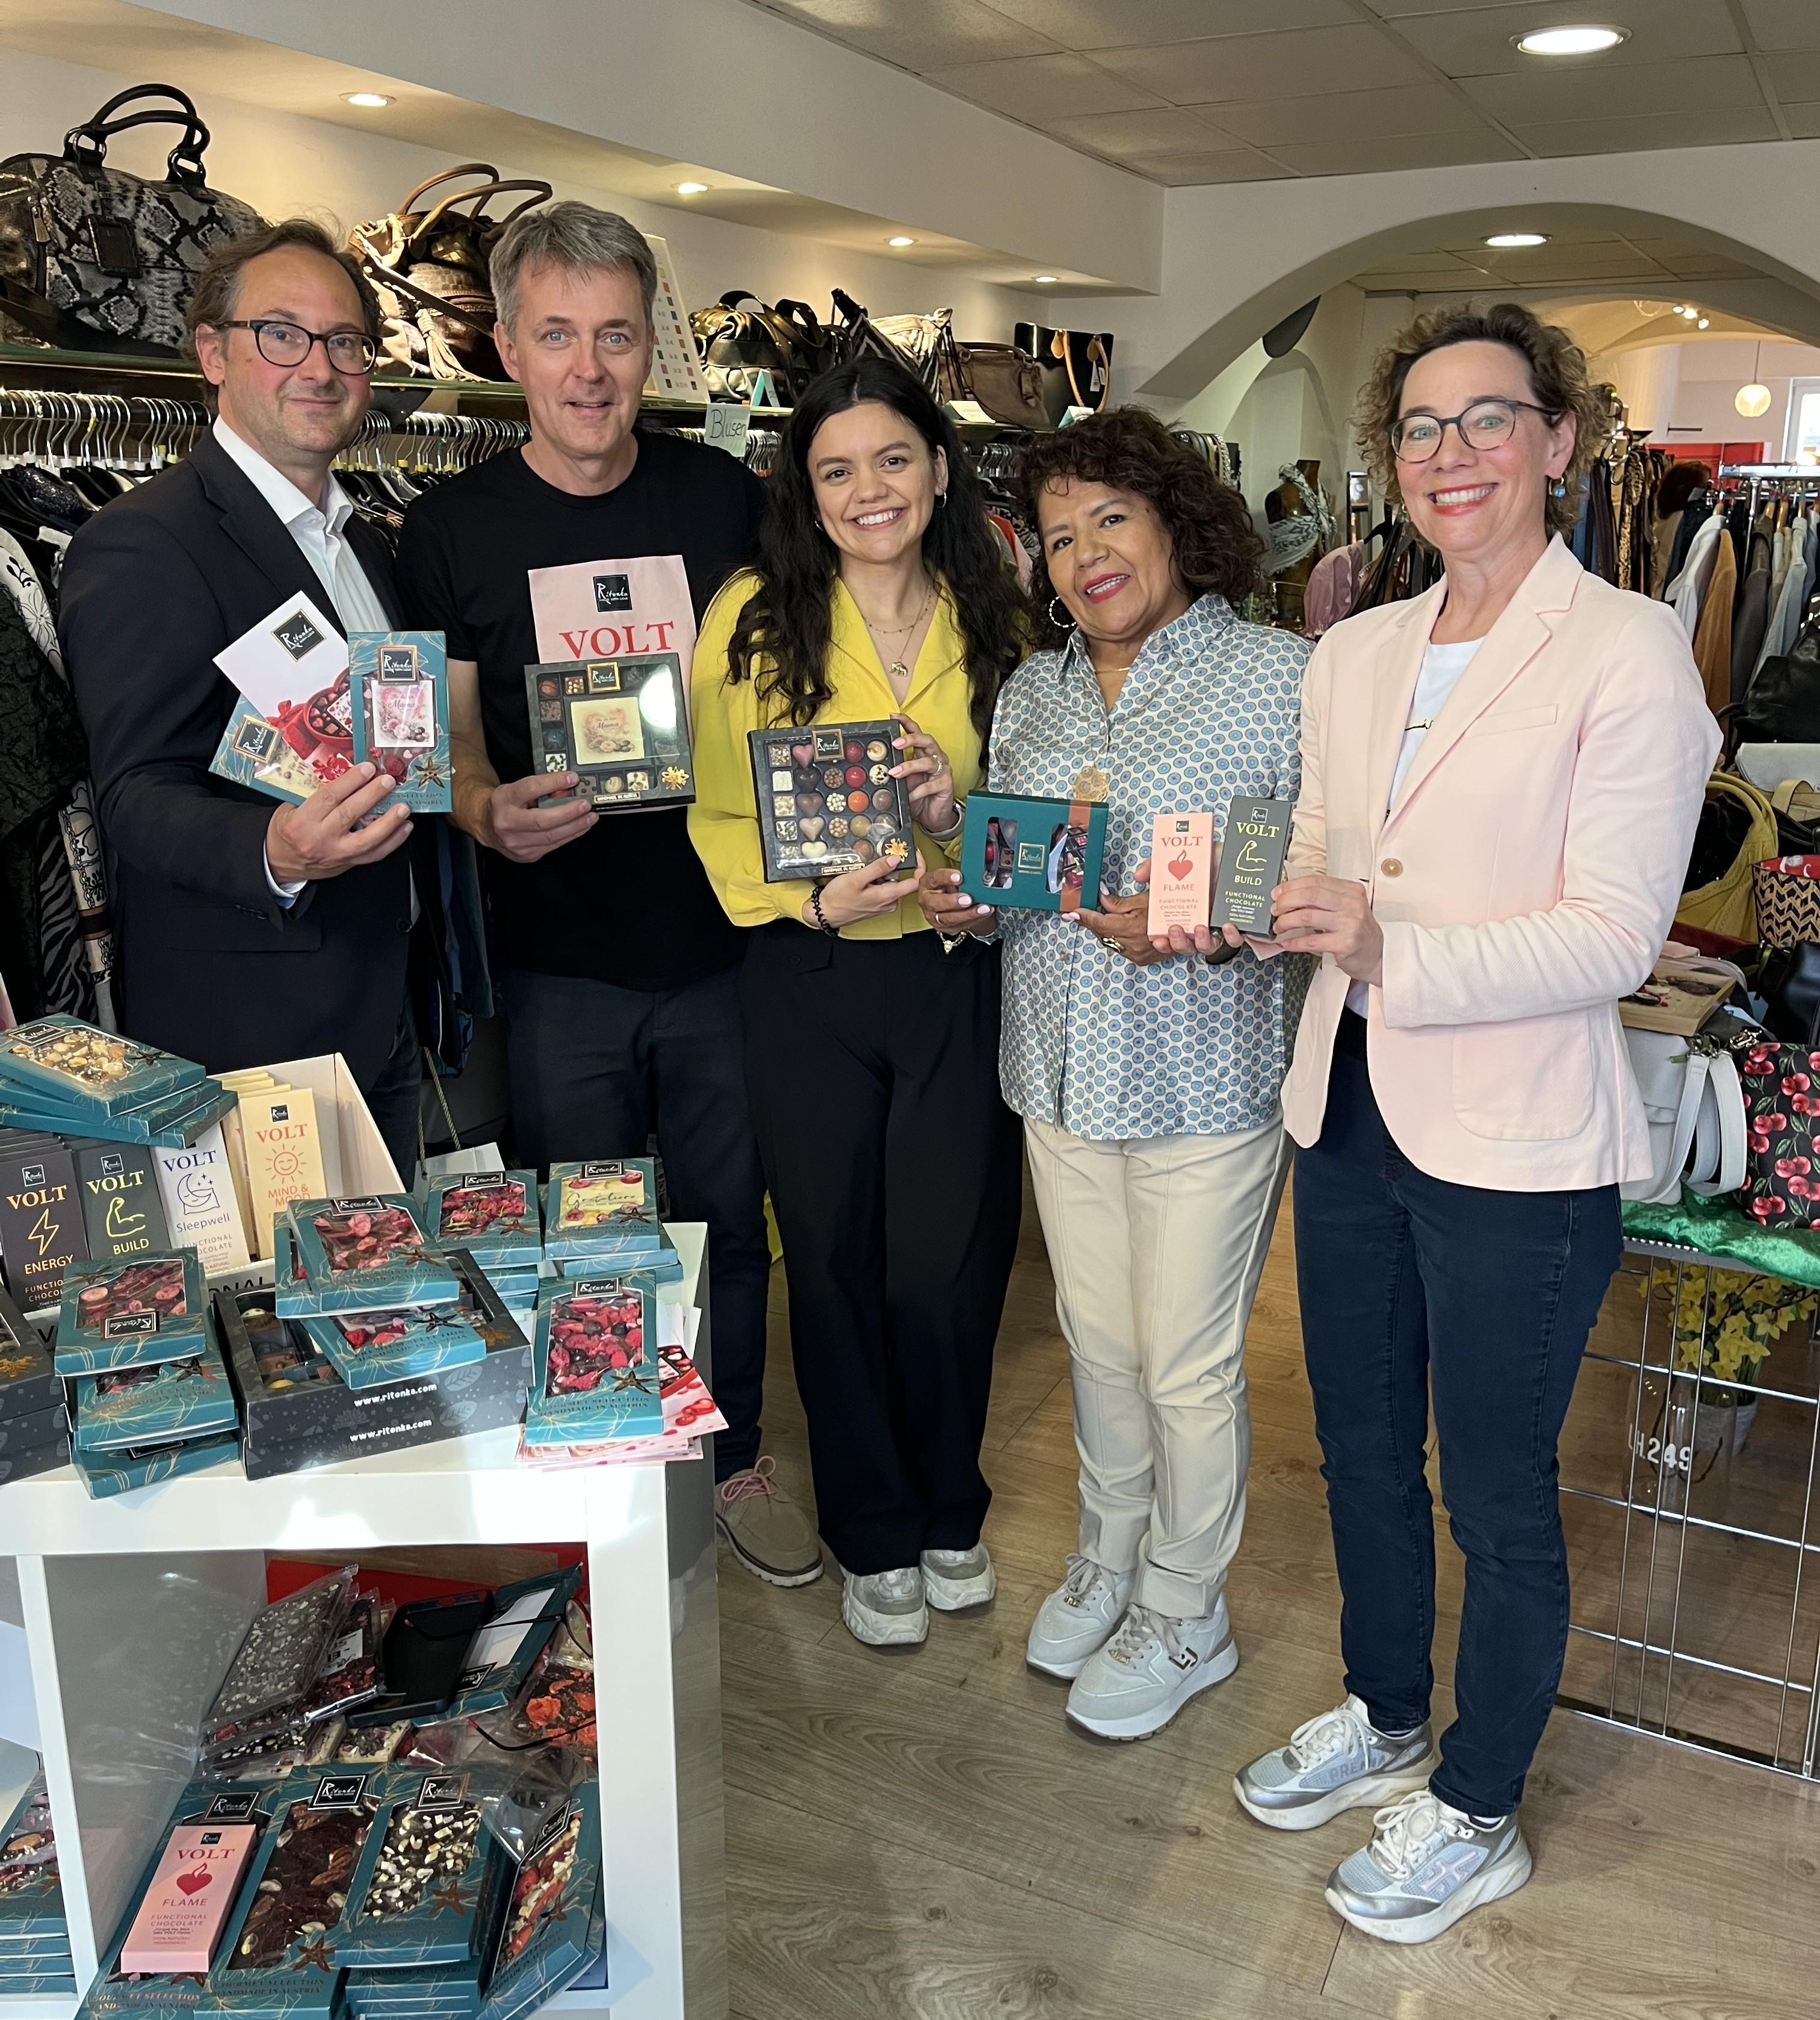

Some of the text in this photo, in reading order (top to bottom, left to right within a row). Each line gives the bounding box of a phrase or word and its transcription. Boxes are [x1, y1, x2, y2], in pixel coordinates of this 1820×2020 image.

[710, 409, 746, 438] Blusen
[559, 621, 674, 659] VOLT
[1236, 822, 1279, 837] VOLT
[1161, 837, 1203, 846] VOLT
[1234, 875, 1262, 885] BUILD
[1225, 891, 1265, 901] FUNCTIONAL
[1225, 898, 1263, 908] CHOCOLATE
[255, 1124, 308, 1143] VOLT
[162, 1150, 216, 1172] VOLT
[86, 1170, 144, 1194] VOLT
[6, 1185, 67, 1209] VOLT
[268, 1183, 308, 1198] MIND &
[176, 1213, 230, 1233] Sleepwell
[113, 1239, 149, 1255] BUILD
[198, 1242, 232, 1255] OCOLATE
[25, 1254, 73, 1274] ENERGY
[25, 1280, 63, 1293] FUNCTIO
[29, 1289, 63, 1302] CHOCOL
[354, 1384, 437, 1407] www.ritonka.com
[350, 1419, 432, 1442] www.ritonka.com
[178, 1848, 235, 1859] VOLT
